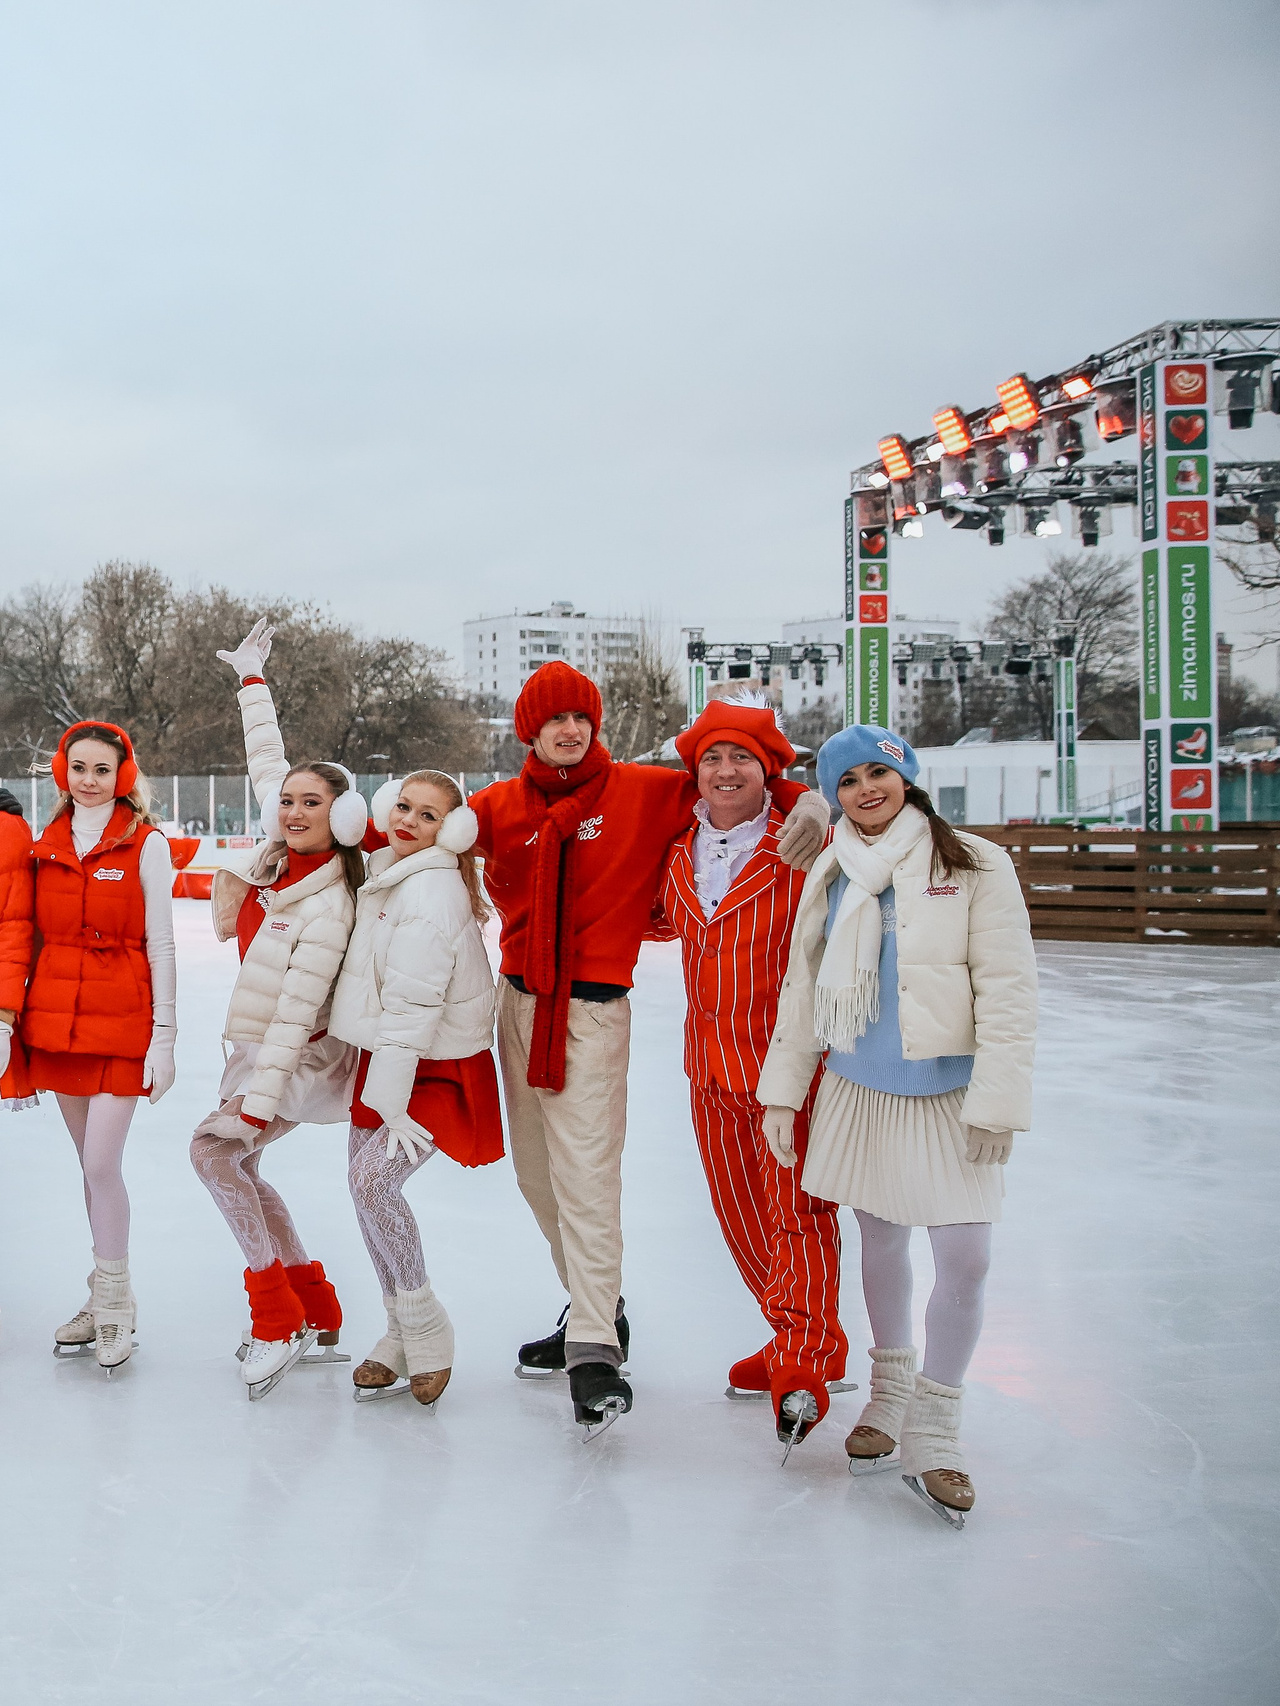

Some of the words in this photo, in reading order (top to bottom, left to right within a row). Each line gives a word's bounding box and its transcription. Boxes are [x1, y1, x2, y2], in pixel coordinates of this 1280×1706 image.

[1144, 452, 1154, 484] НА
[1147, 574, 1157, 695] zima.mos.ru
[1179, 563, 1198, 701] zima.mos.ru
